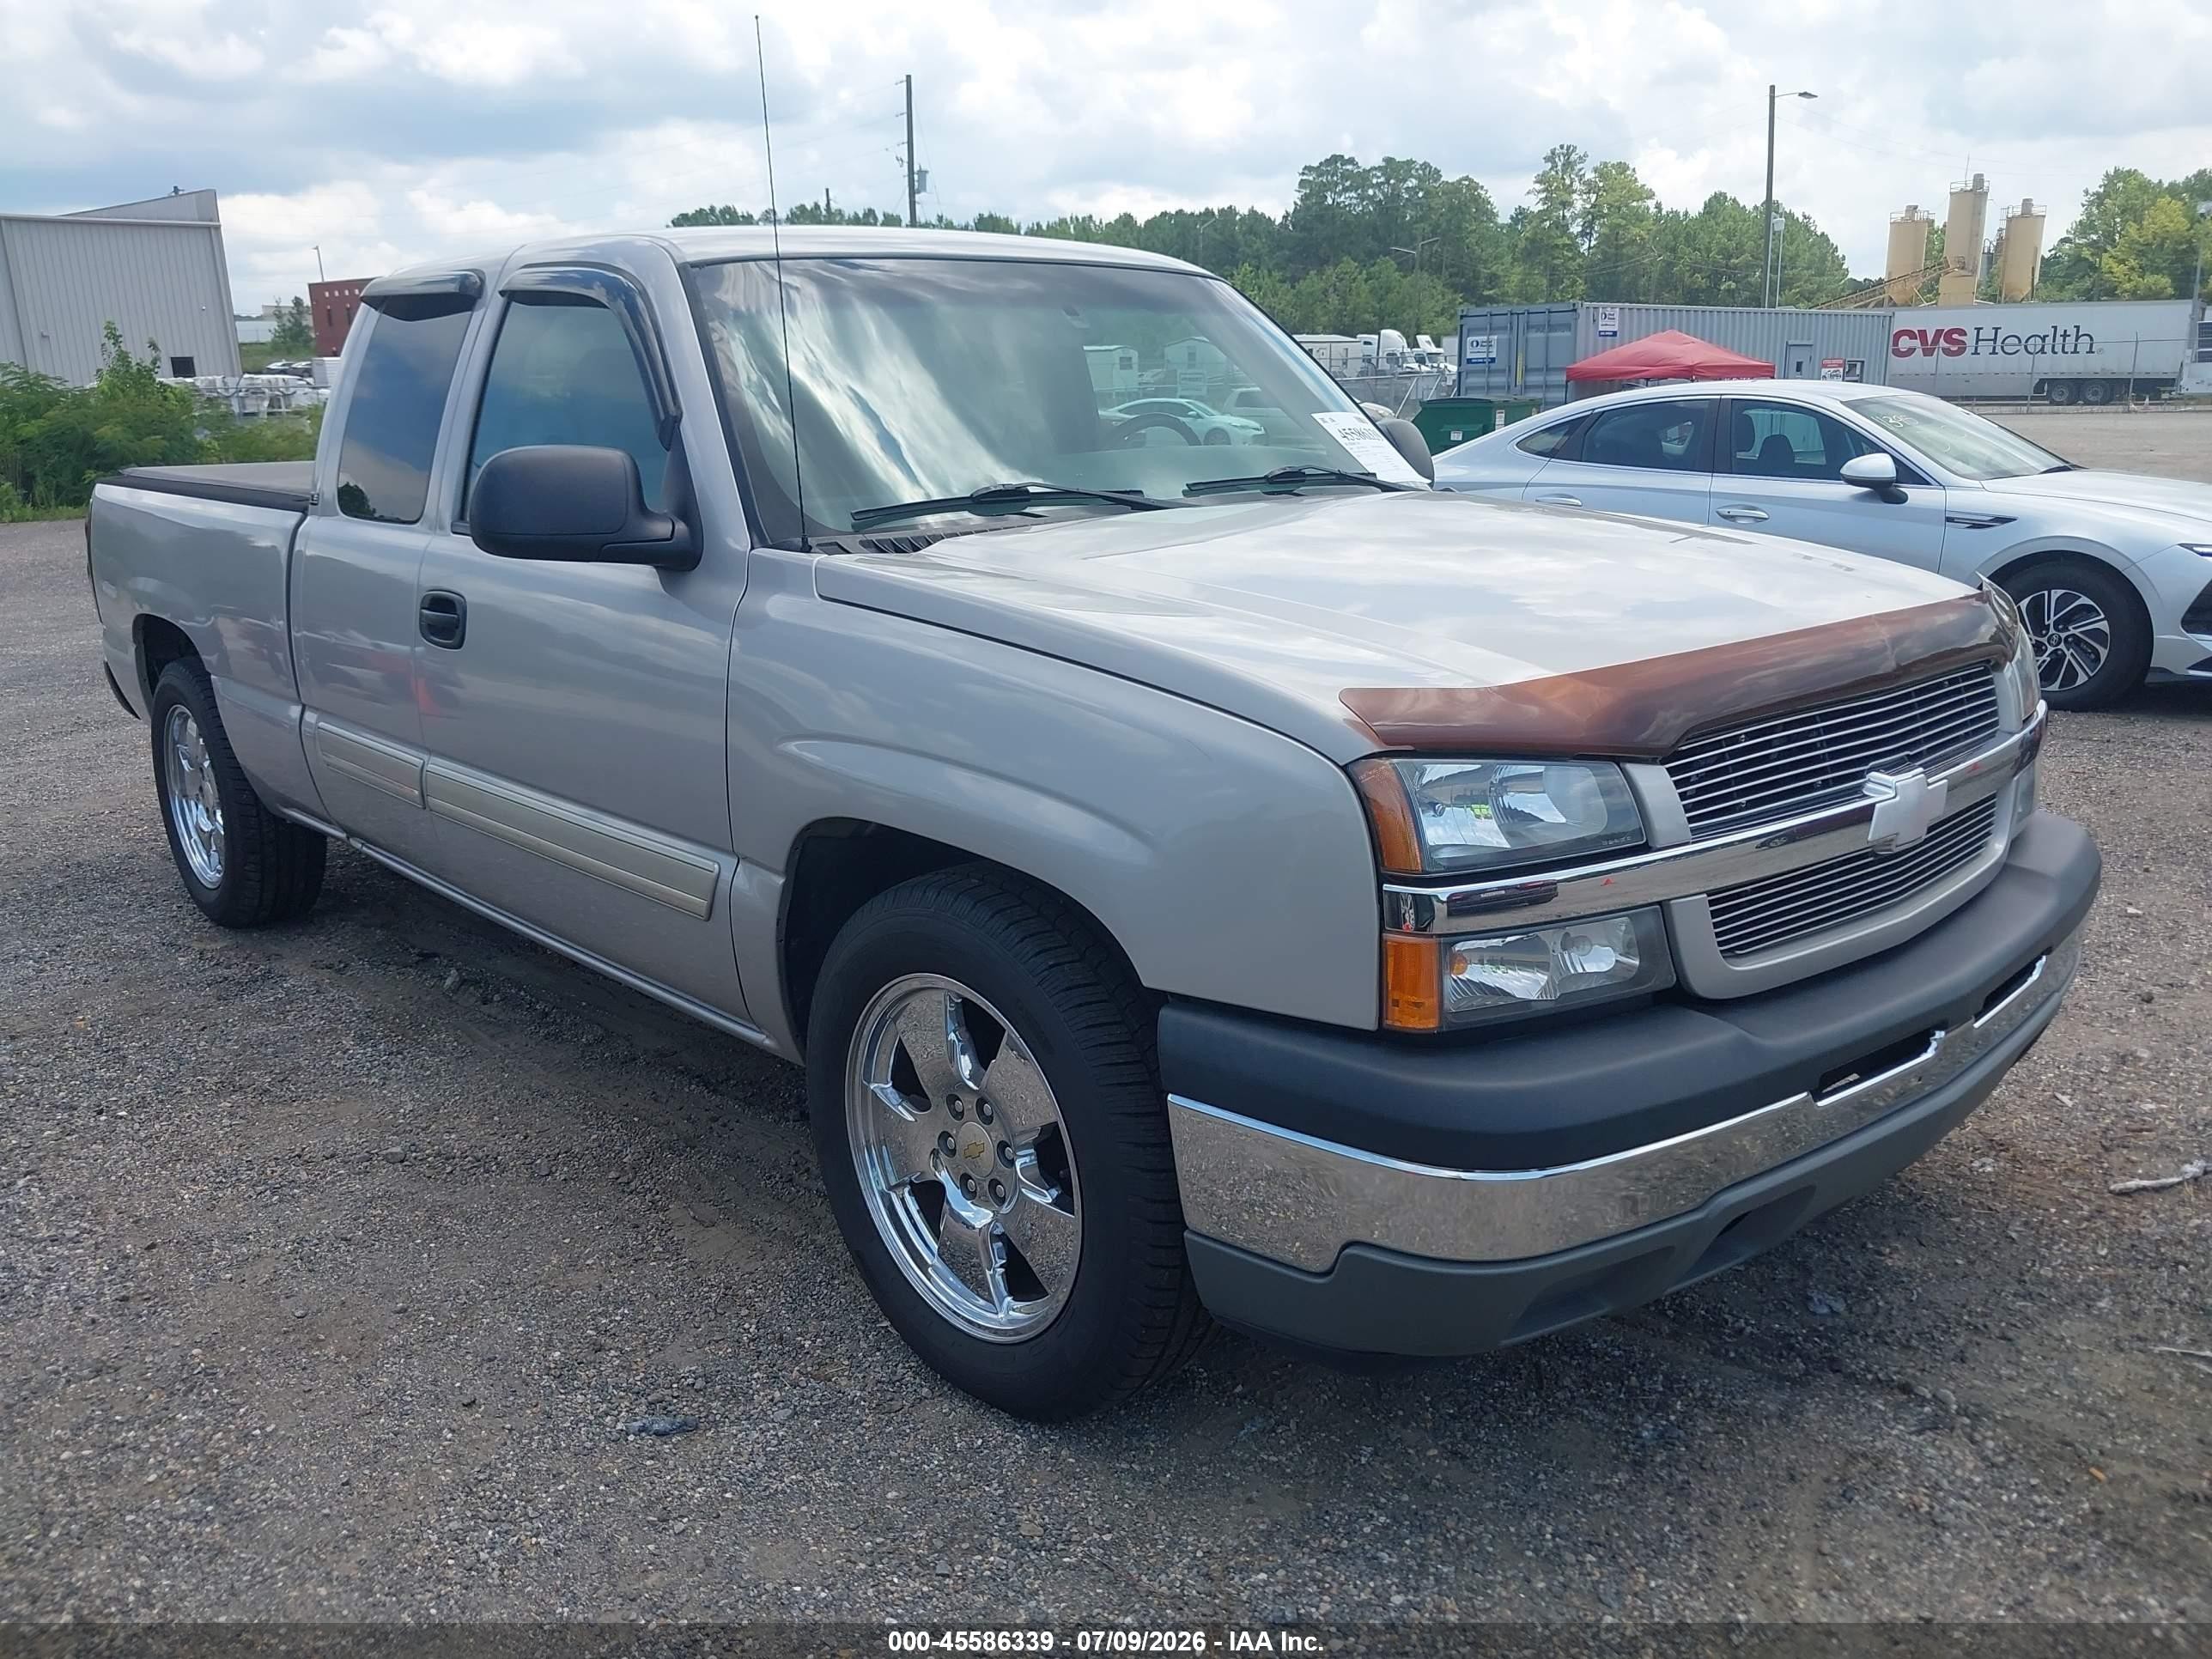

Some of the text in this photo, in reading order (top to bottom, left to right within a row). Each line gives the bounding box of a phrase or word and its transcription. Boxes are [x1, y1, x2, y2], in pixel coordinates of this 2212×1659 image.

[1891, 325, 2096, 358] CVS Health
[1337, 428, 1384, 441] 45586
